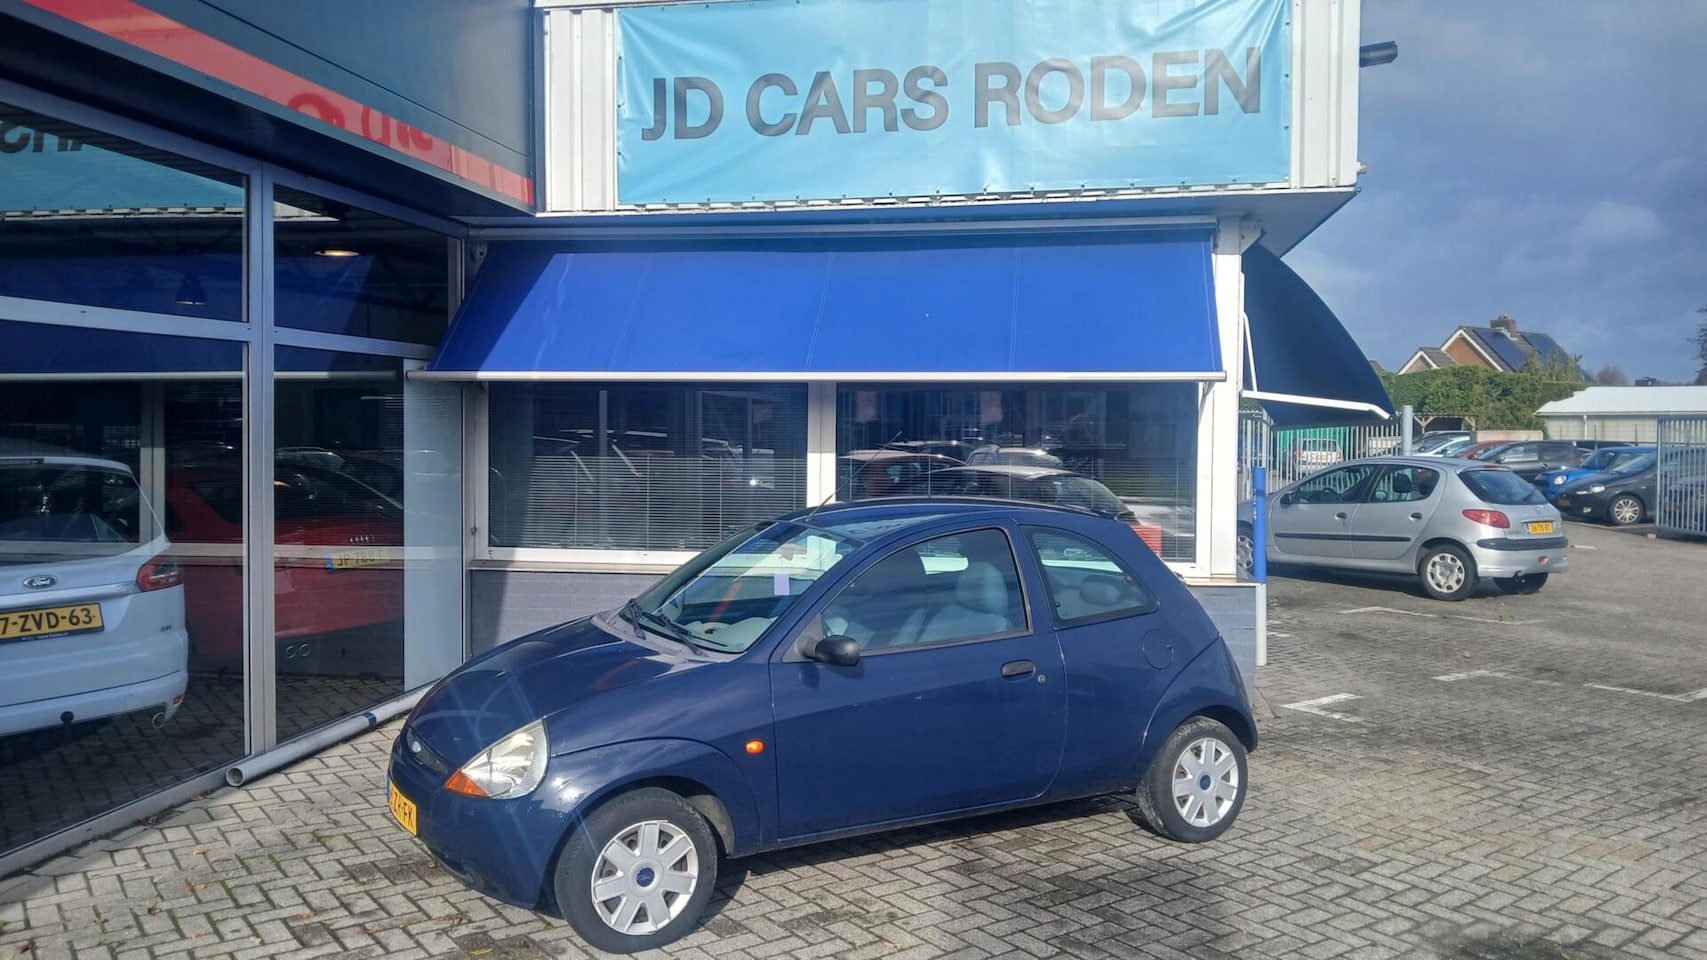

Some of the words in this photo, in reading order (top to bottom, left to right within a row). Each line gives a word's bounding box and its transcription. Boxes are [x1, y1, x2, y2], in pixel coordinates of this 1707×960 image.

[641, 77, 723, 141] JD
[745, 67, 950, 137] CARS
[973, 46, 1262, 130] RODEN
